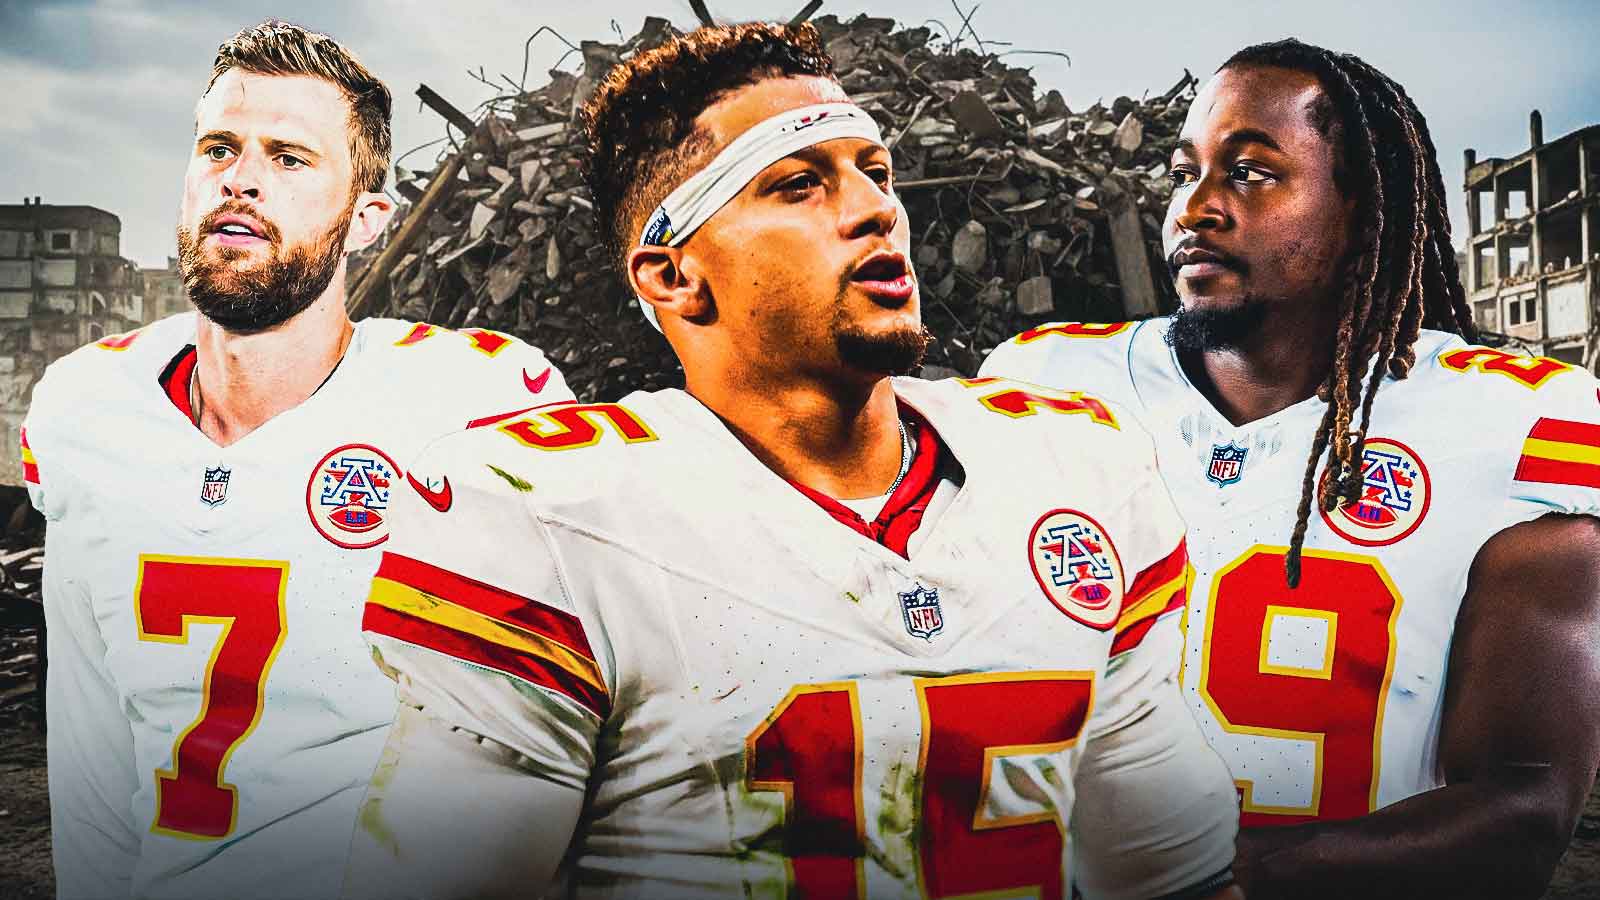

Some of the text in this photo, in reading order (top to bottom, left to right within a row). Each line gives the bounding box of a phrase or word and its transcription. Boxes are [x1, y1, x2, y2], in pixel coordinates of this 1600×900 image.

[204, 483, 225, 500] NFL
[320, 457, 388, 510] A
[1212, 460, 1237, 478] NFL
[1047, 523, 1114, 587] A
[911, 608, 940, 630] NFL
[134, 553, 290, 838] 7
[1181, 544, 1403, 827] 9
[745, 670, 1095, 900] 15
